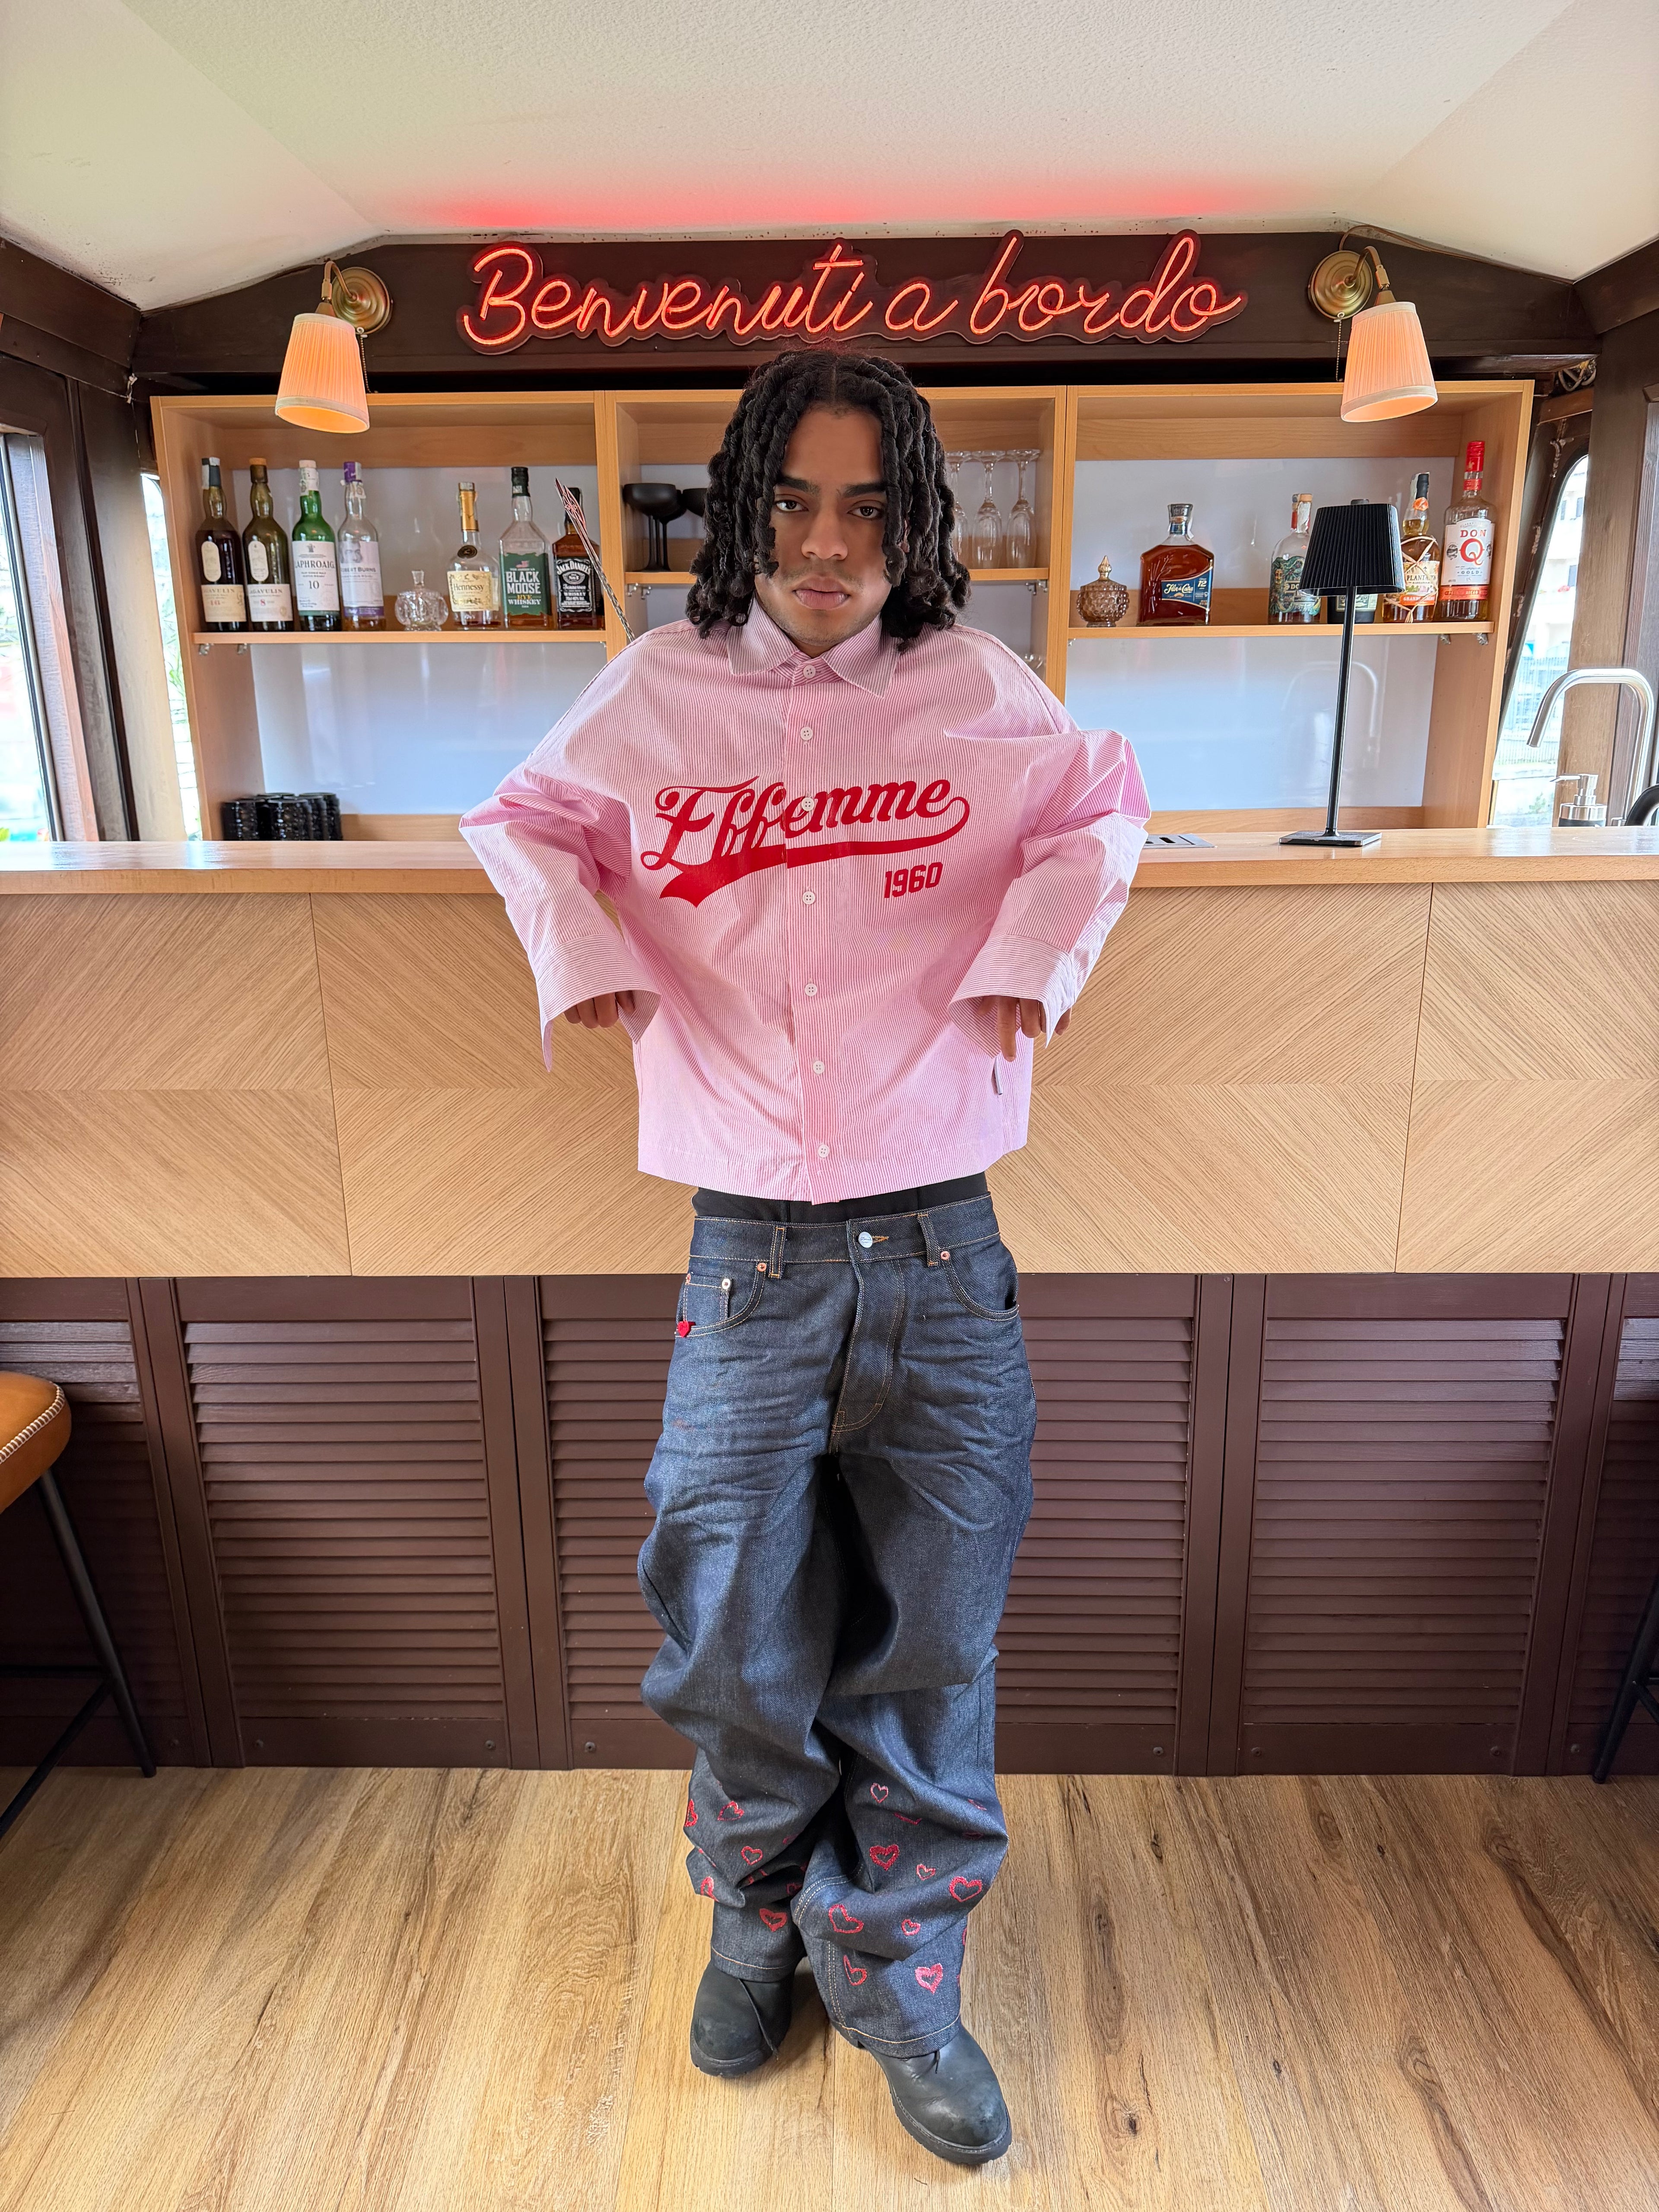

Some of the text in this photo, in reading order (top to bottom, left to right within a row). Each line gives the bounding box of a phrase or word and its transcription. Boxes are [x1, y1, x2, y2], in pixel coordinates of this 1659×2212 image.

[462, 236, 1243, 345] Benvenuti a bordo
[1460, 530, 1487, 538] DON
[1460, 538, 1484, 566] Q
[295, 560, 335, 569] APHROAIG
[556, 563, 570, 575] JACK
[506, 571, 540, 582] BLACK
[309, 580, 319, 589] 10
[454, 584, 485, 592] Hennessy
[507, 583, 541, 594] MOOSE
[1164, 583, 1178, 594] Flor
[884, 861, 944, 899] 1960
